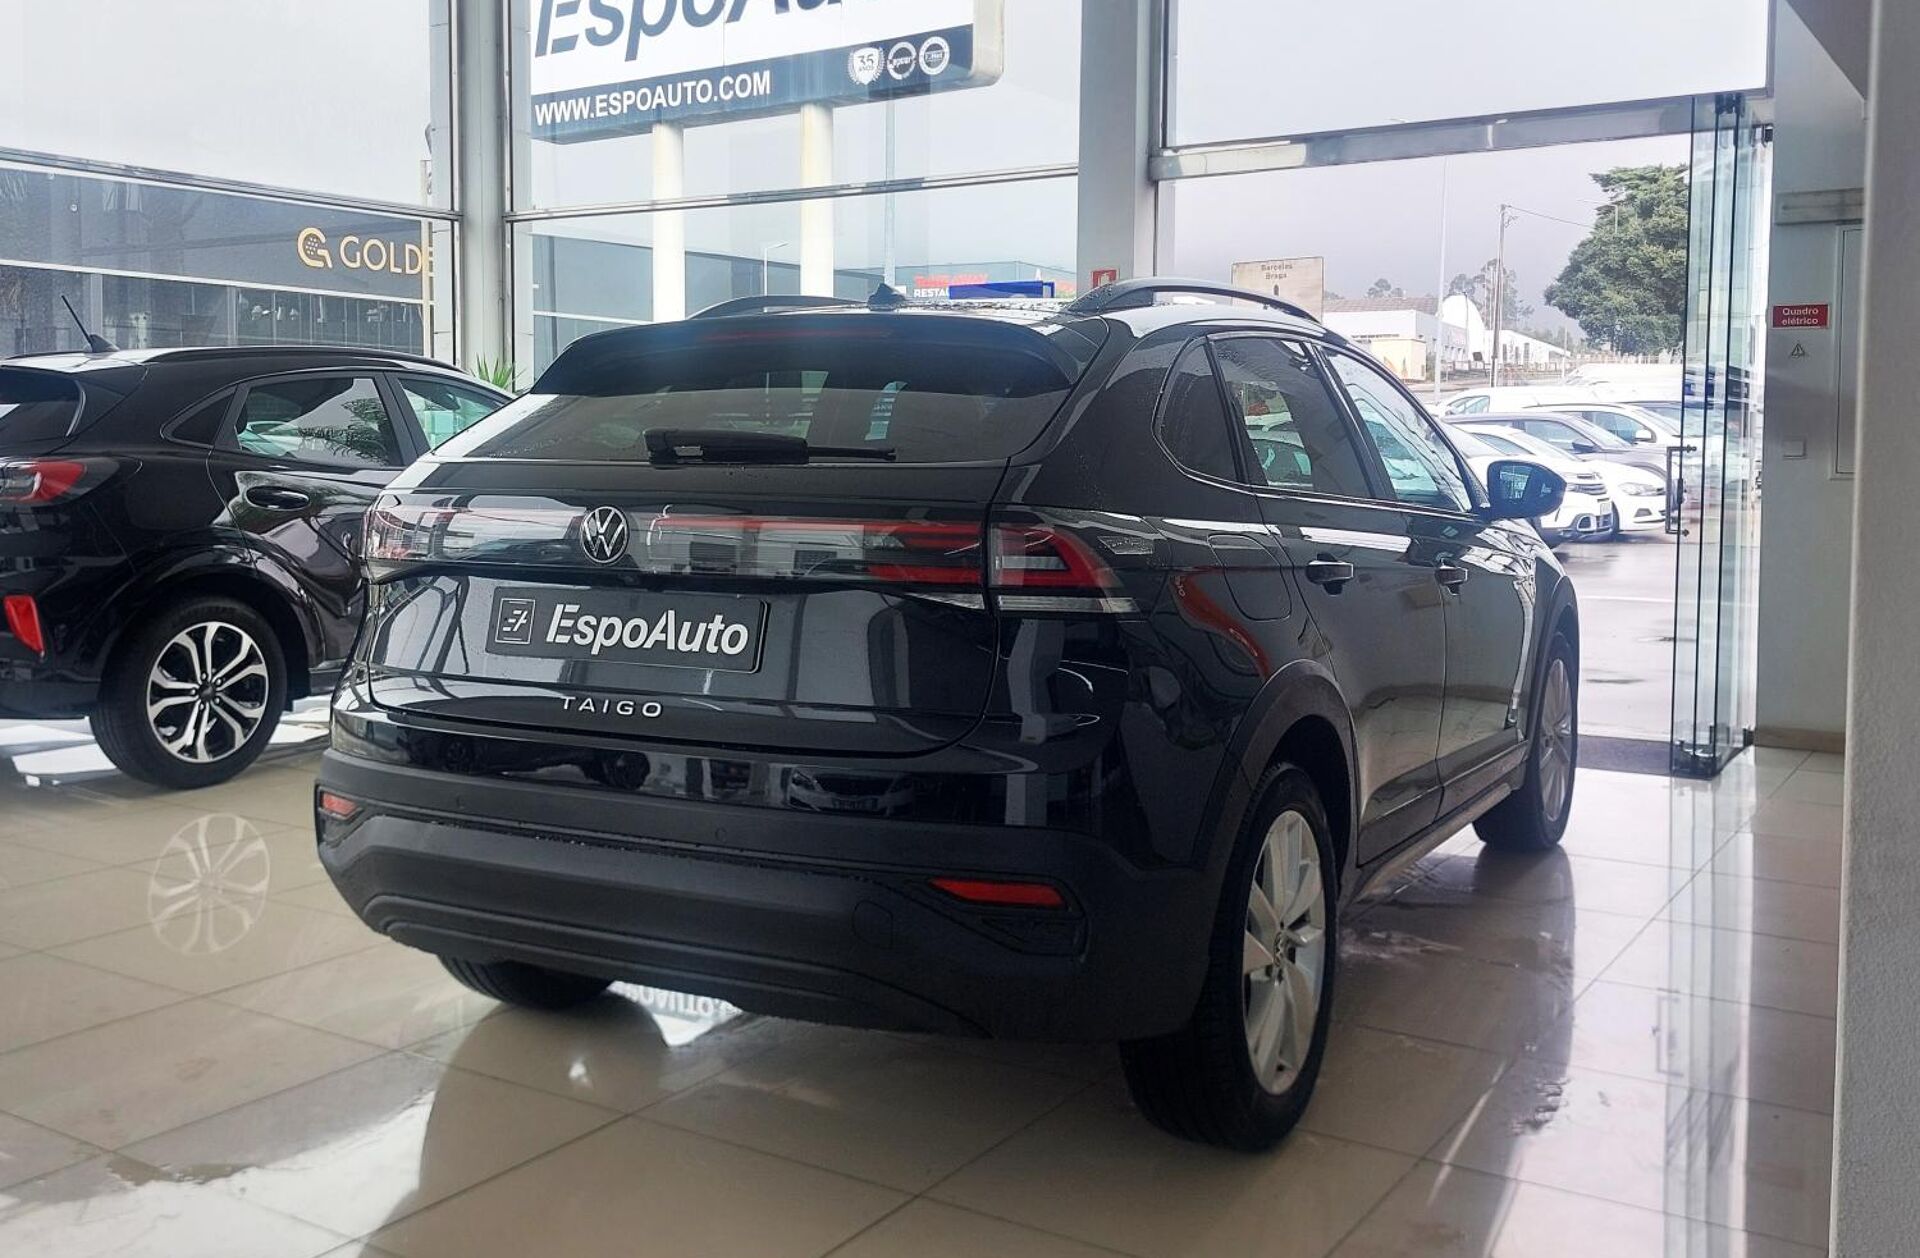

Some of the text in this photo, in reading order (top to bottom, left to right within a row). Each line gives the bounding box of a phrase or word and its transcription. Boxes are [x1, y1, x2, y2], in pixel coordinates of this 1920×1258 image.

[535, 70, 771, 125] WWW.ESPOAUTO.COM
[1261, 263, 1293, 271] Barcelos
[1265, 272, 1287, 280] Braga
[1782, 307, 1819, 316] Quadro
[1782, 316, 1819, 326] elétrico
[546, 603, 749, 656] EspoAuto
[561, 697, 662, 718] TAIGO
